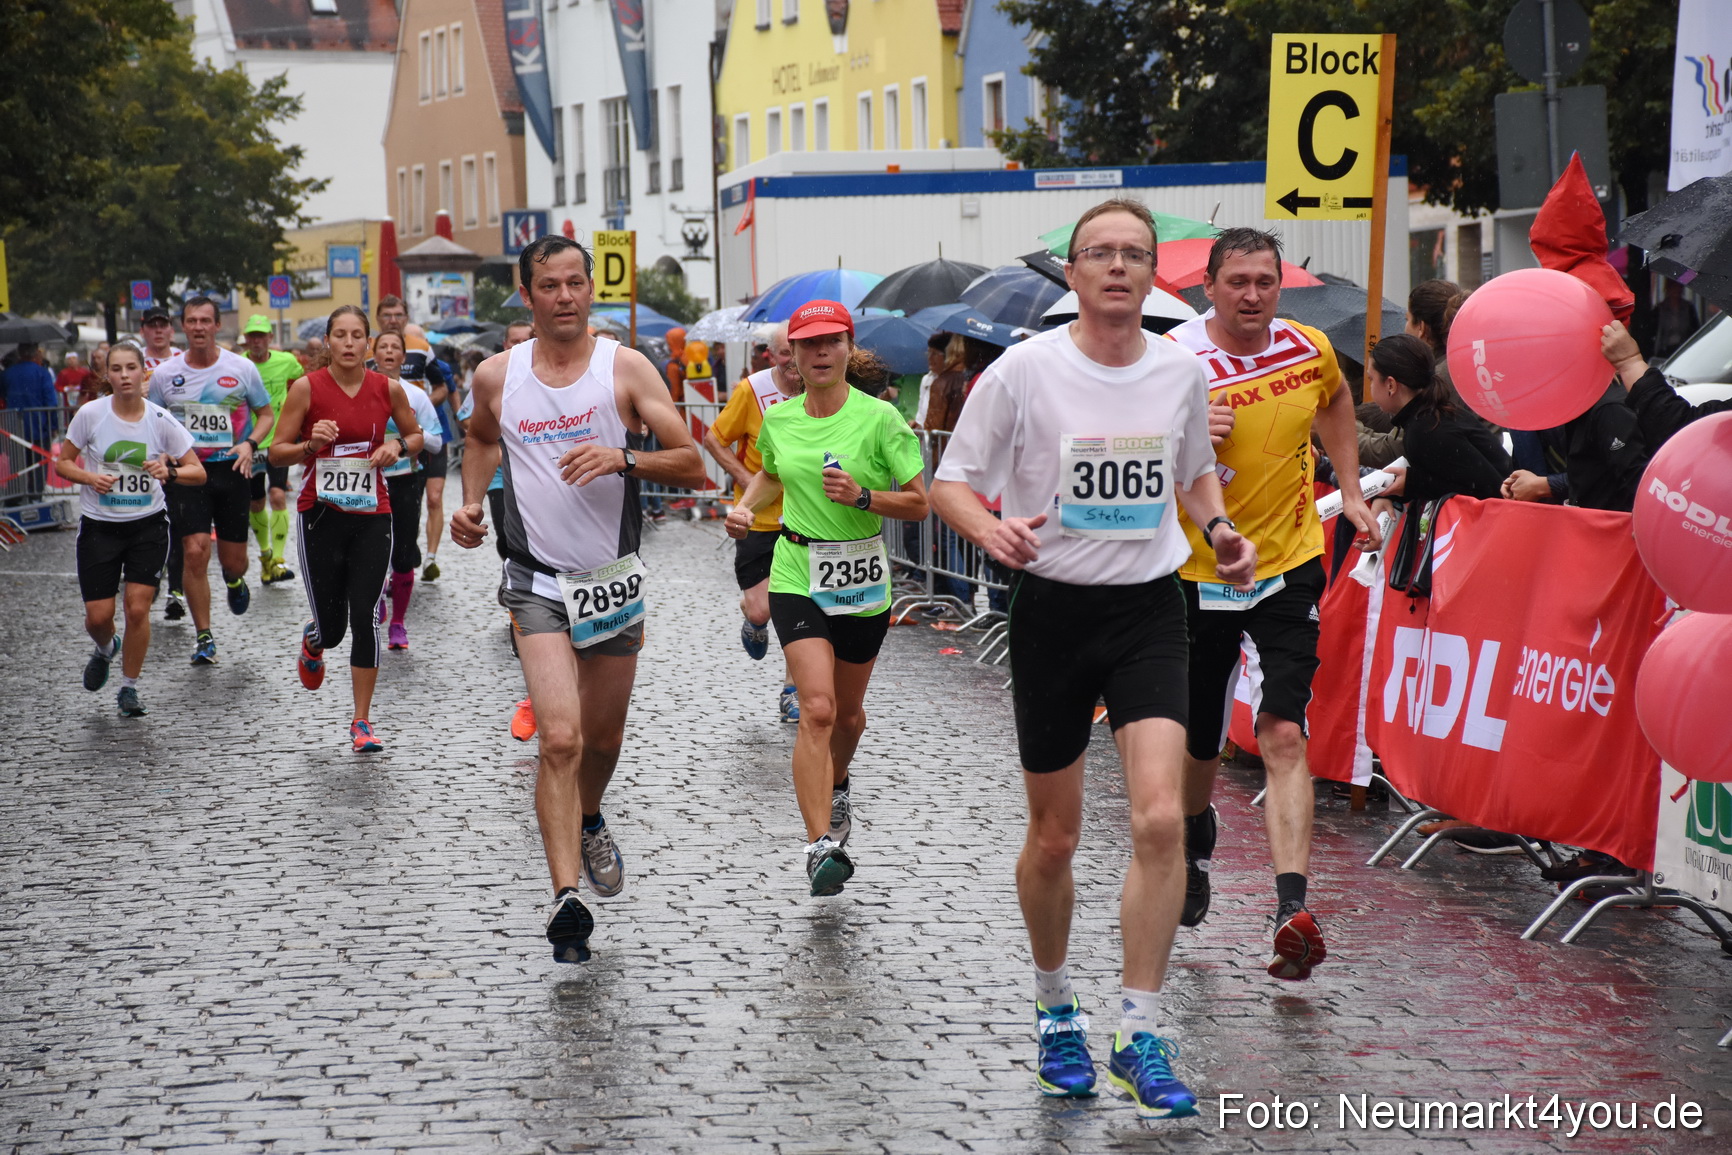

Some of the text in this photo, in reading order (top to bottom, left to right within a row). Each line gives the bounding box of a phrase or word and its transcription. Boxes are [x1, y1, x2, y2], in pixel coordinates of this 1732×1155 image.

[1285, 42, 1379, 75] Block
[1297, 89, 1360, 181] C
[597, 233, 631, 247] Block
[604, 252, 625, 286] D
[1268, 366, 1324, 397] BÖGL
[190, 414, 228, 431] 2493
[522, 427, 592, 444] Pure Performance
[1070, 446, 1107, 454] NeuerMarkt
[1113, 436, 1164, 451] BOCK
[323, 471, 371, 493] 2074
[1072, 459, 1164, 500] 3065
[110, 496, 142, 506] Ramona
[345, 496, 371, 506] Sophie
[1083, 507, 1136, 524] Stefan
[847, 539, 880, 554] BOCK
[597, 558, 634, 579] BOCK
[819, 555, 883, 588] 2356
[573, 573, 642, 619] 2899
[835, 591, 865, 605] Ingrid
[593, 612, 630, 633] Markus
